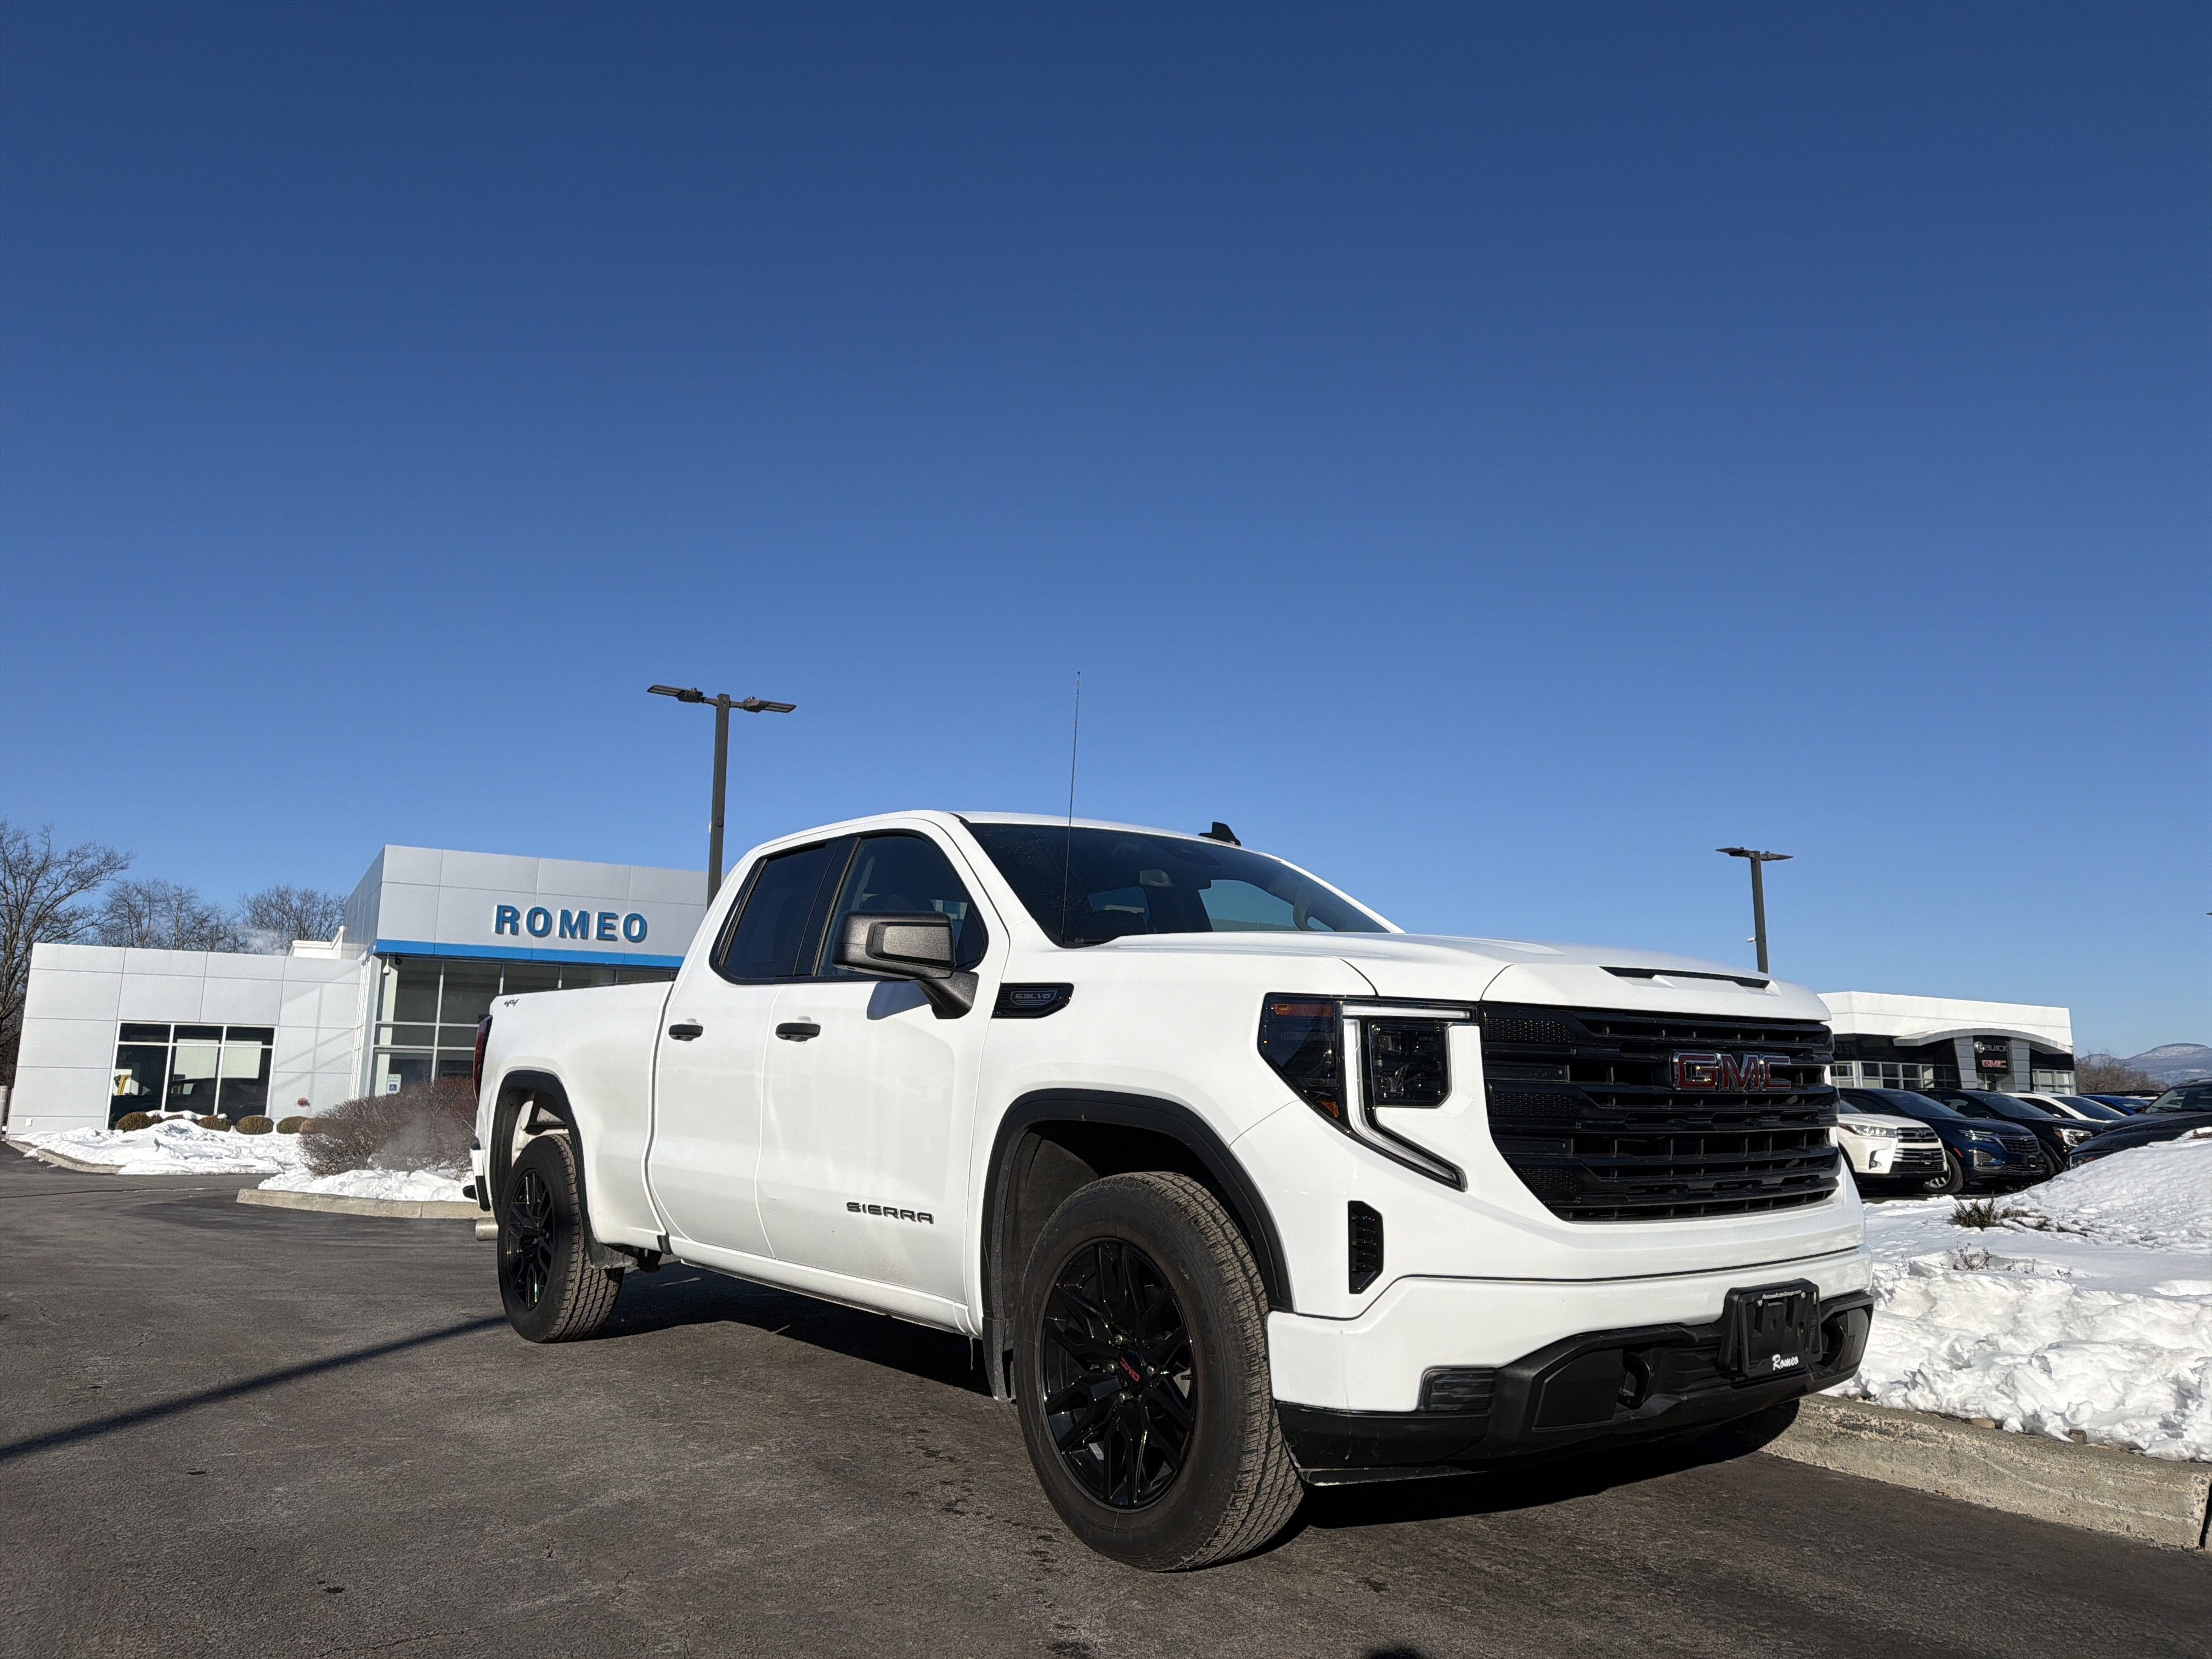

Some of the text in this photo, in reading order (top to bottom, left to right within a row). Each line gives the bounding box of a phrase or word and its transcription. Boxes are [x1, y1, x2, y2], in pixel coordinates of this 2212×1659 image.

[494, 904, 647, 943] ROMEO
[1673, 1052, 1791, 1092] GMC
[1982, 1059, 2007, 1068] GMC
[847, 1201, 934, 1224] SIERRA
[1120, 1357, 1140, 1382] GMC
[1772, 1353, 1799, 1371] Romeo
